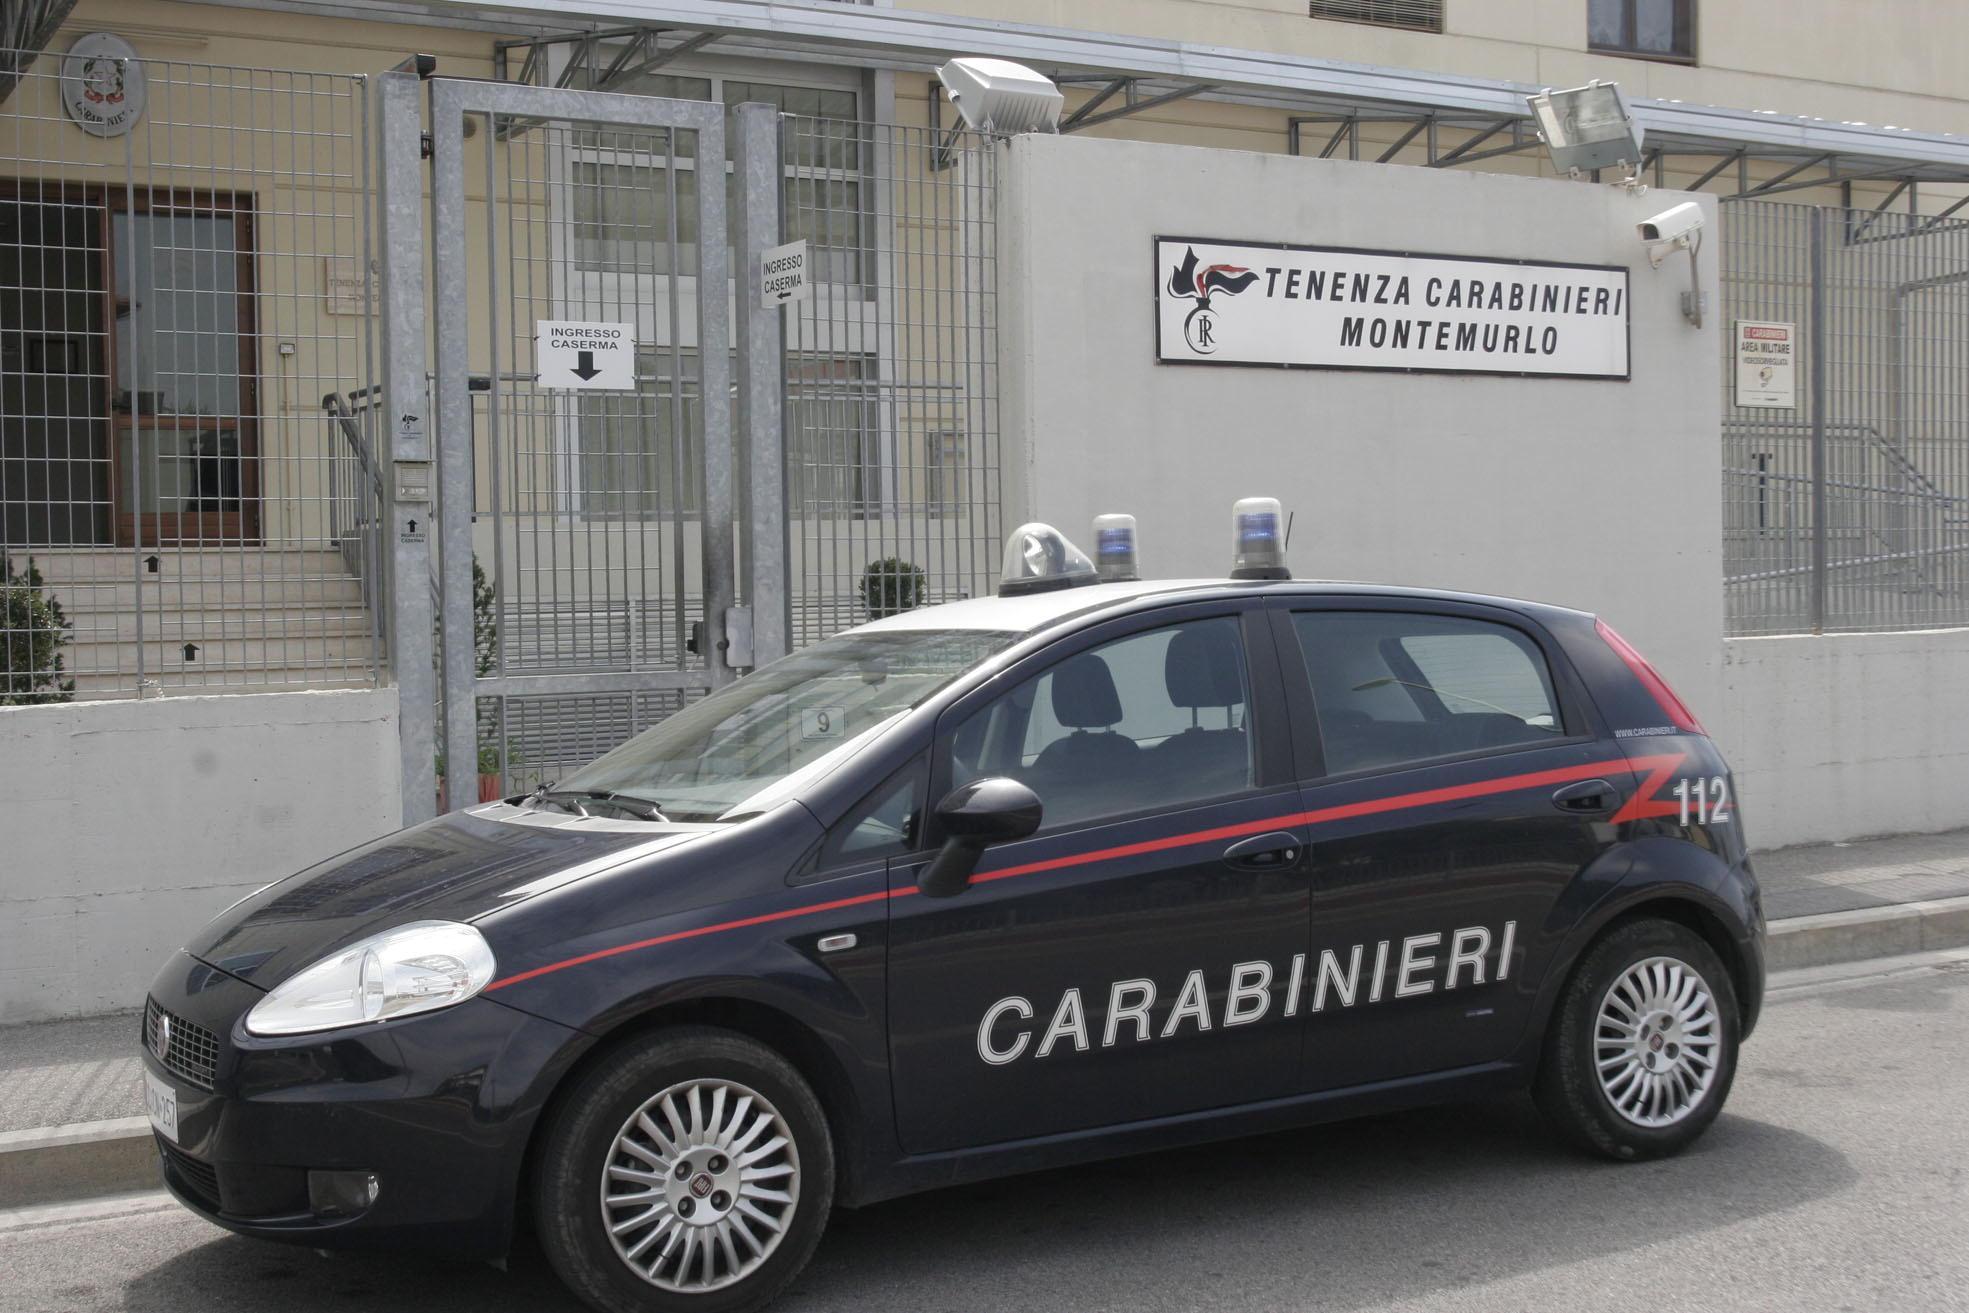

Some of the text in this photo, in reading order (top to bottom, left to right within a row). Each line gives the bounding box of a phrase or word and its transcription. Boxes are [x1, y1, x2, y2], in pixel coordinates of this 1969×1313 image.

[763, 254, 803, 275] INGRESSO
[764, 274, 802, 294] CASERMA
[1265, 267, 1622, 316] TENENZA CARABINIERI
[551, 328, 621, 338] INGRESSO
[1340, 317, 1558, 355] MONTEMURLO
[551, 339, 619, 350] CASERMA
[1741, 341, 1790, 354] AREA MILITARE
[817, 712, 830, 733] 9
[1673, 776, 1728, 826] 112
[976, 920, 1516, 1065] CARABINIERI
